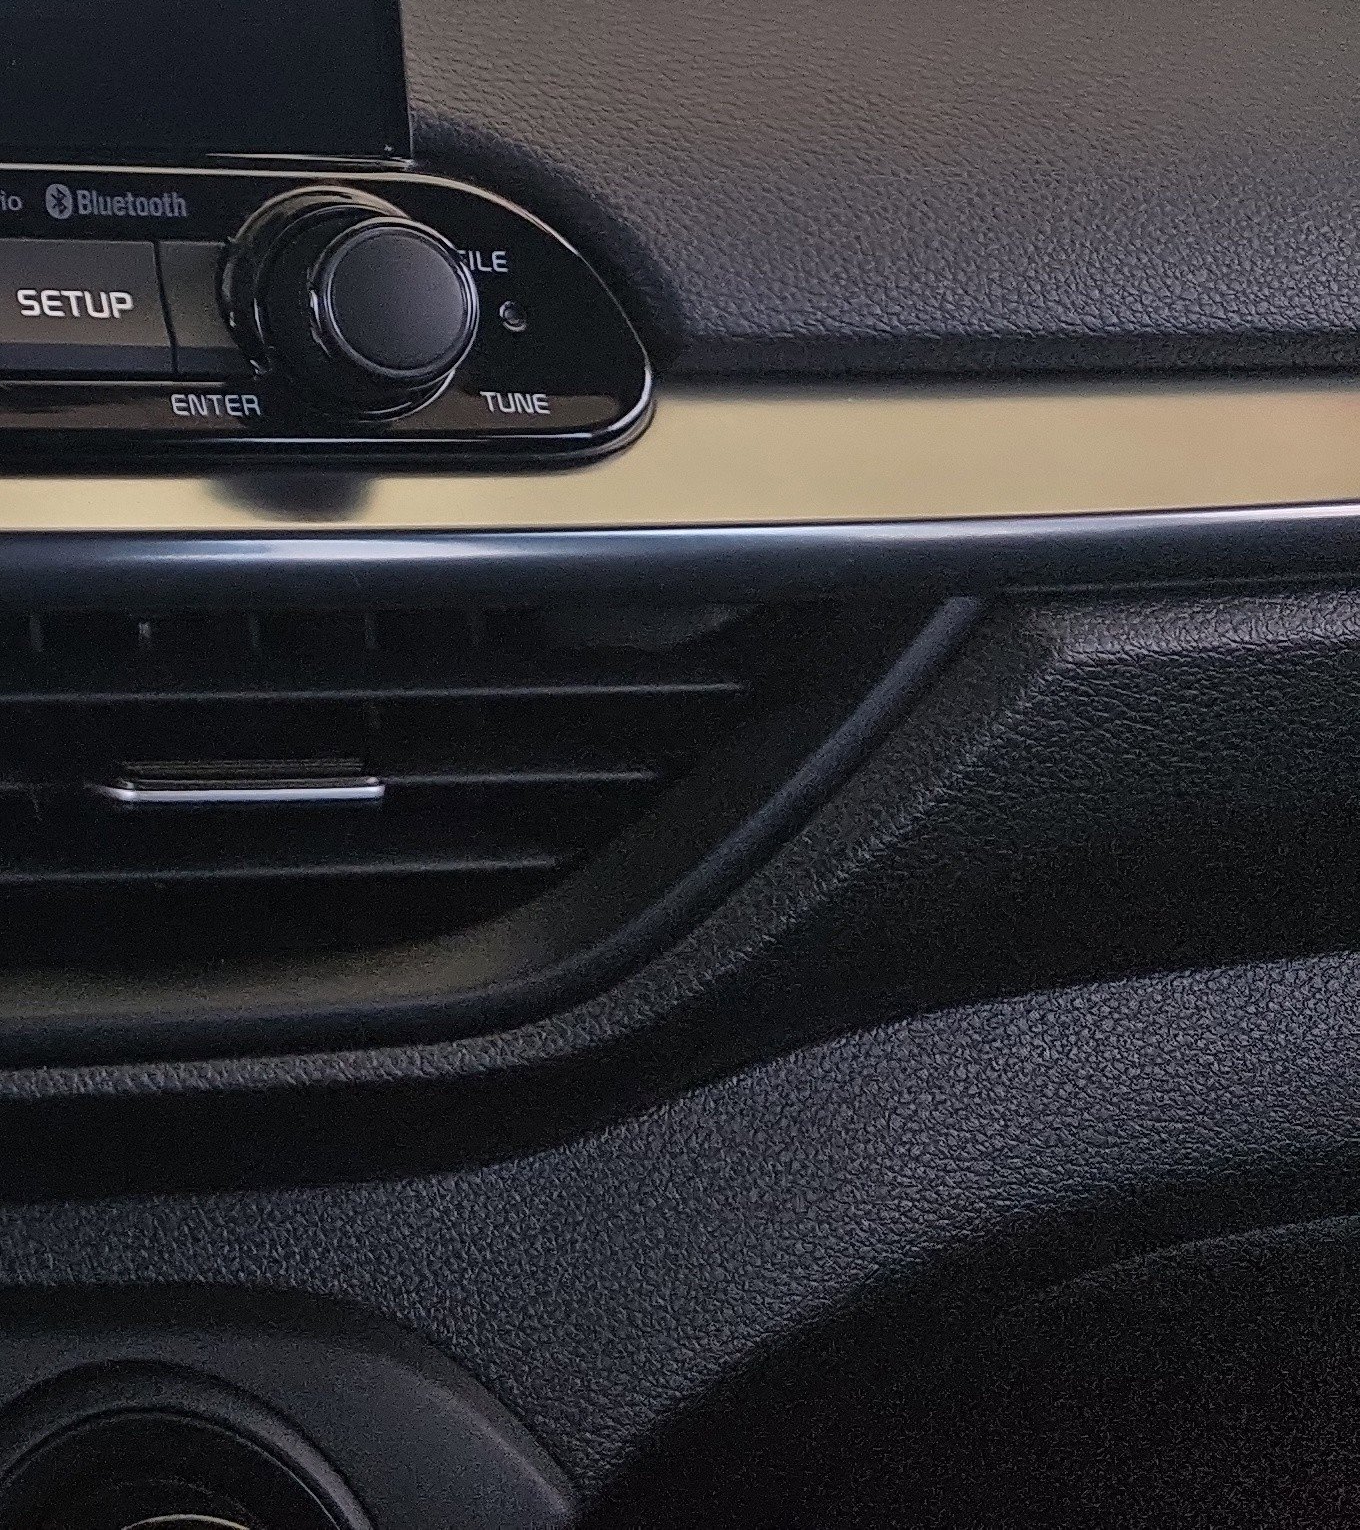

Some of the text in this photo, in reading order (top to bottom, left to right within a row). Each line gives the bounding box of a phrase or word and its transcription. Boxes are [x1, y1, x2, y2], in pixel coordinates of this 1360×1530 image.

[76, 189, 188, 218] Bluetooth
[17, 289, 133, 319] SETUP
[170, 393, 261, 417] ENTER
[480, 391, 551, 415] TUNE
